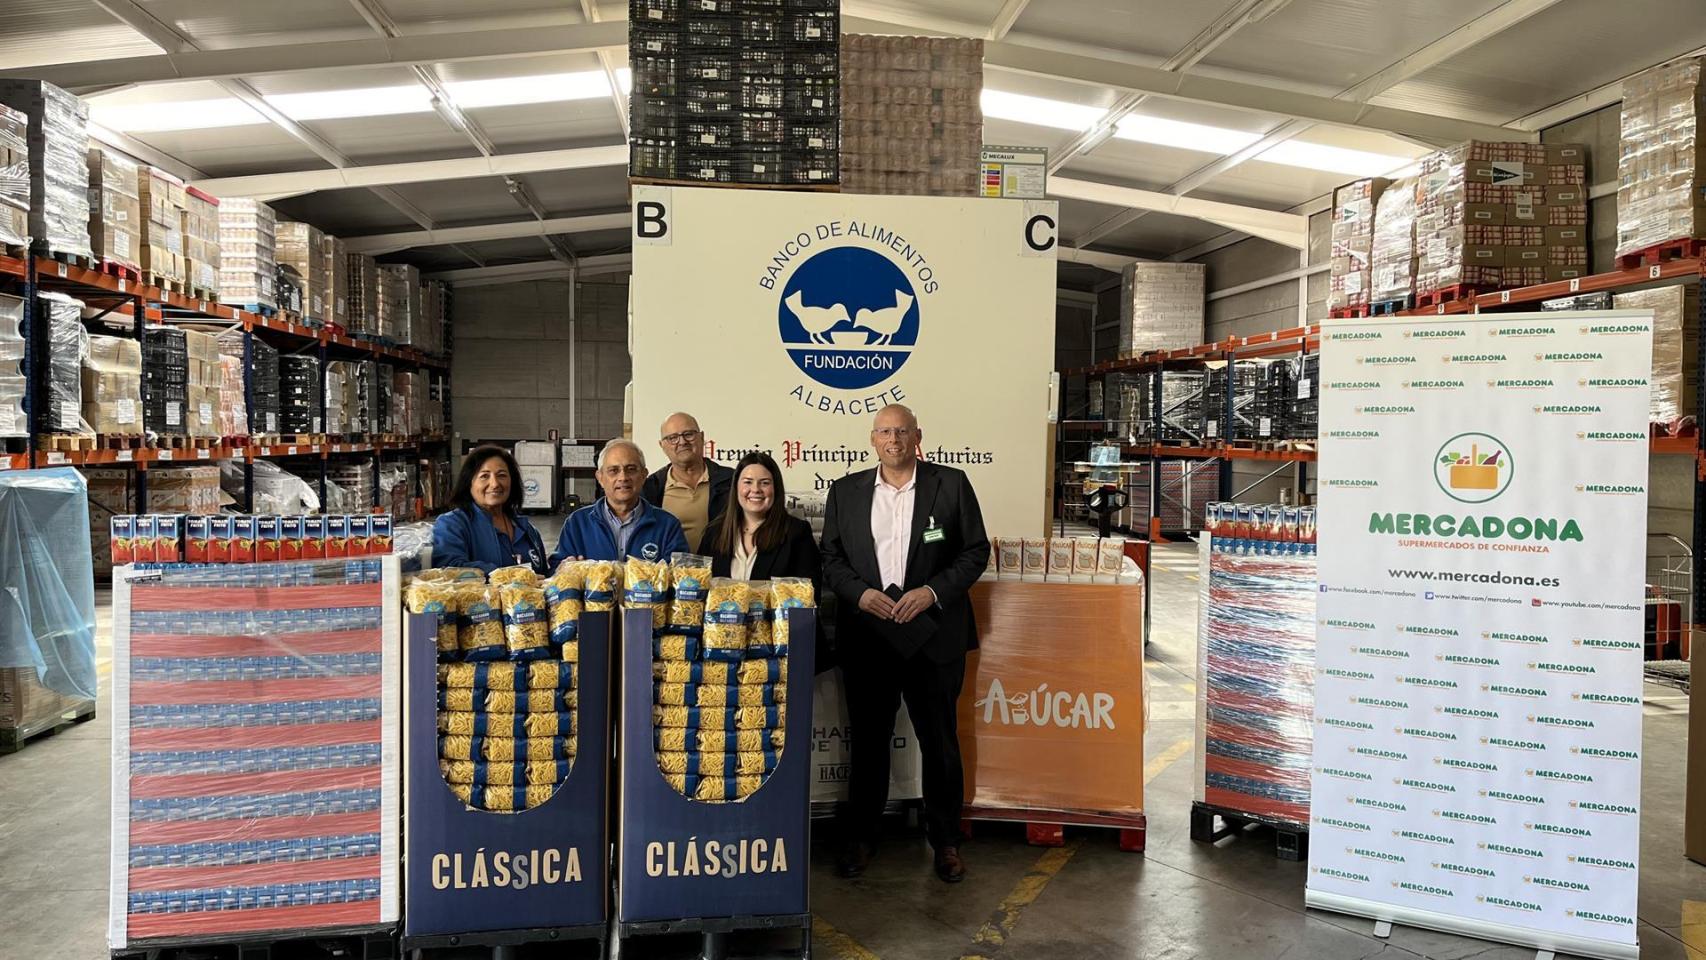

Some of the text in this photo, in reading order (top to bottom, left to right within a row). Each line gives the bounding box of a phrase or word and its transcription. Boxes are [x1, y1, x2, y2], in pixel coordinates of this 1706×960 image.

[637, 202, 667, 238] B
[1025, 215, 1055, 251] C
[759, 221, 939, 294] BANCO DE ALIMENTOS
[804, 353, 893, 370] FUNDACIÓN
[790, 385, 905, 415] ALBACETE
[1587, 432, 1645, 440] MERCADONA
[782, 440, 870, 468] Príncipe
[1369, 512, 1584, 542] MERCADONA
[1398, 539, 1475, 550] SUPERMERCADOS
[1492, 544, 1551, 553] CONFIANZA
[1388, 568, 1560, 587] www.mercadona.es
[1542, 600, 1641, 611] www.youtube.com/mercadona
[1327, 620, 1375, 629] MERCADONA
[1406, 626, 1459, 636] MERCADONA
[1492, 633, 1548, 643] MERCADONA
[1583, 639, 1641, 649] MERCADONA
[1359, 648, 1409, 657] MERCADONA
[1445, 656, 1500, 666] MERCADONA
[1326, 669, 1374, 679] MERCADONA
[1537, 663, 1595, 674] MERCADONA
[1405, 677, 1457, 688] MERCADONA
[1491, 686, 1547, 697] MERCADONA
[1358, 698, 1408, 708] MERCADONA
[1582, 694, 1640, 704] MERCADONA
[1444, 707, 1498, 718] MERCADONA
[1325, 719, 1373, 729] MERCADONA
[1537, 716, 1594, 728] MERCADONA
[1404, 728, 1456, 740] MERCADONA
[1490, 738, 1546, 750] MERCADONA
[1357, 748, 1407, 760] MERCADONA
[1581, 748, 1638, 759] MERCADONA
[1443, 759, 1497, 771] MERCADONA
[1323, 768, 1372, 780] MERCADONA
[1536, 770, 1593, 782] MERCADONA
[1403, 780, 1456, 792] MERCADONA
[1488, 791, 1544, 803] MERCADONA
[1355, 798, 1406, 811] MERCADONA
[1579, 802, 1637, 813] MERCADONA
[1442, 811, 1496, 823] MERCADONA
[1322, 818, 1371, 830] MERCADONA
[1535, 824, 1591, 836] MERCADONA
[1402, 831, 1454, 844] MERCADONA
[1355, 849, 1405, 861] MERCADONA
[1488, 844, 1543, 856] MERCADONA
[646, 837, 788, 879] CLÁSSICA
[1578, 857, 1636, 869] MERCADONA
[432, 847, 582, 890] CLÁSSICA
[1320, 868, 1369, 881] MERCADONA
[1441, 863, 1495, 876] MERCADONA
[1400, 882, 1453, 895] MERCADONA
[1533, 878, 1590, 890] MERCADONA
[1486, 897, 1542, 910] MERCADONA
[1576, 911, 1633, 924] MERCADONA
